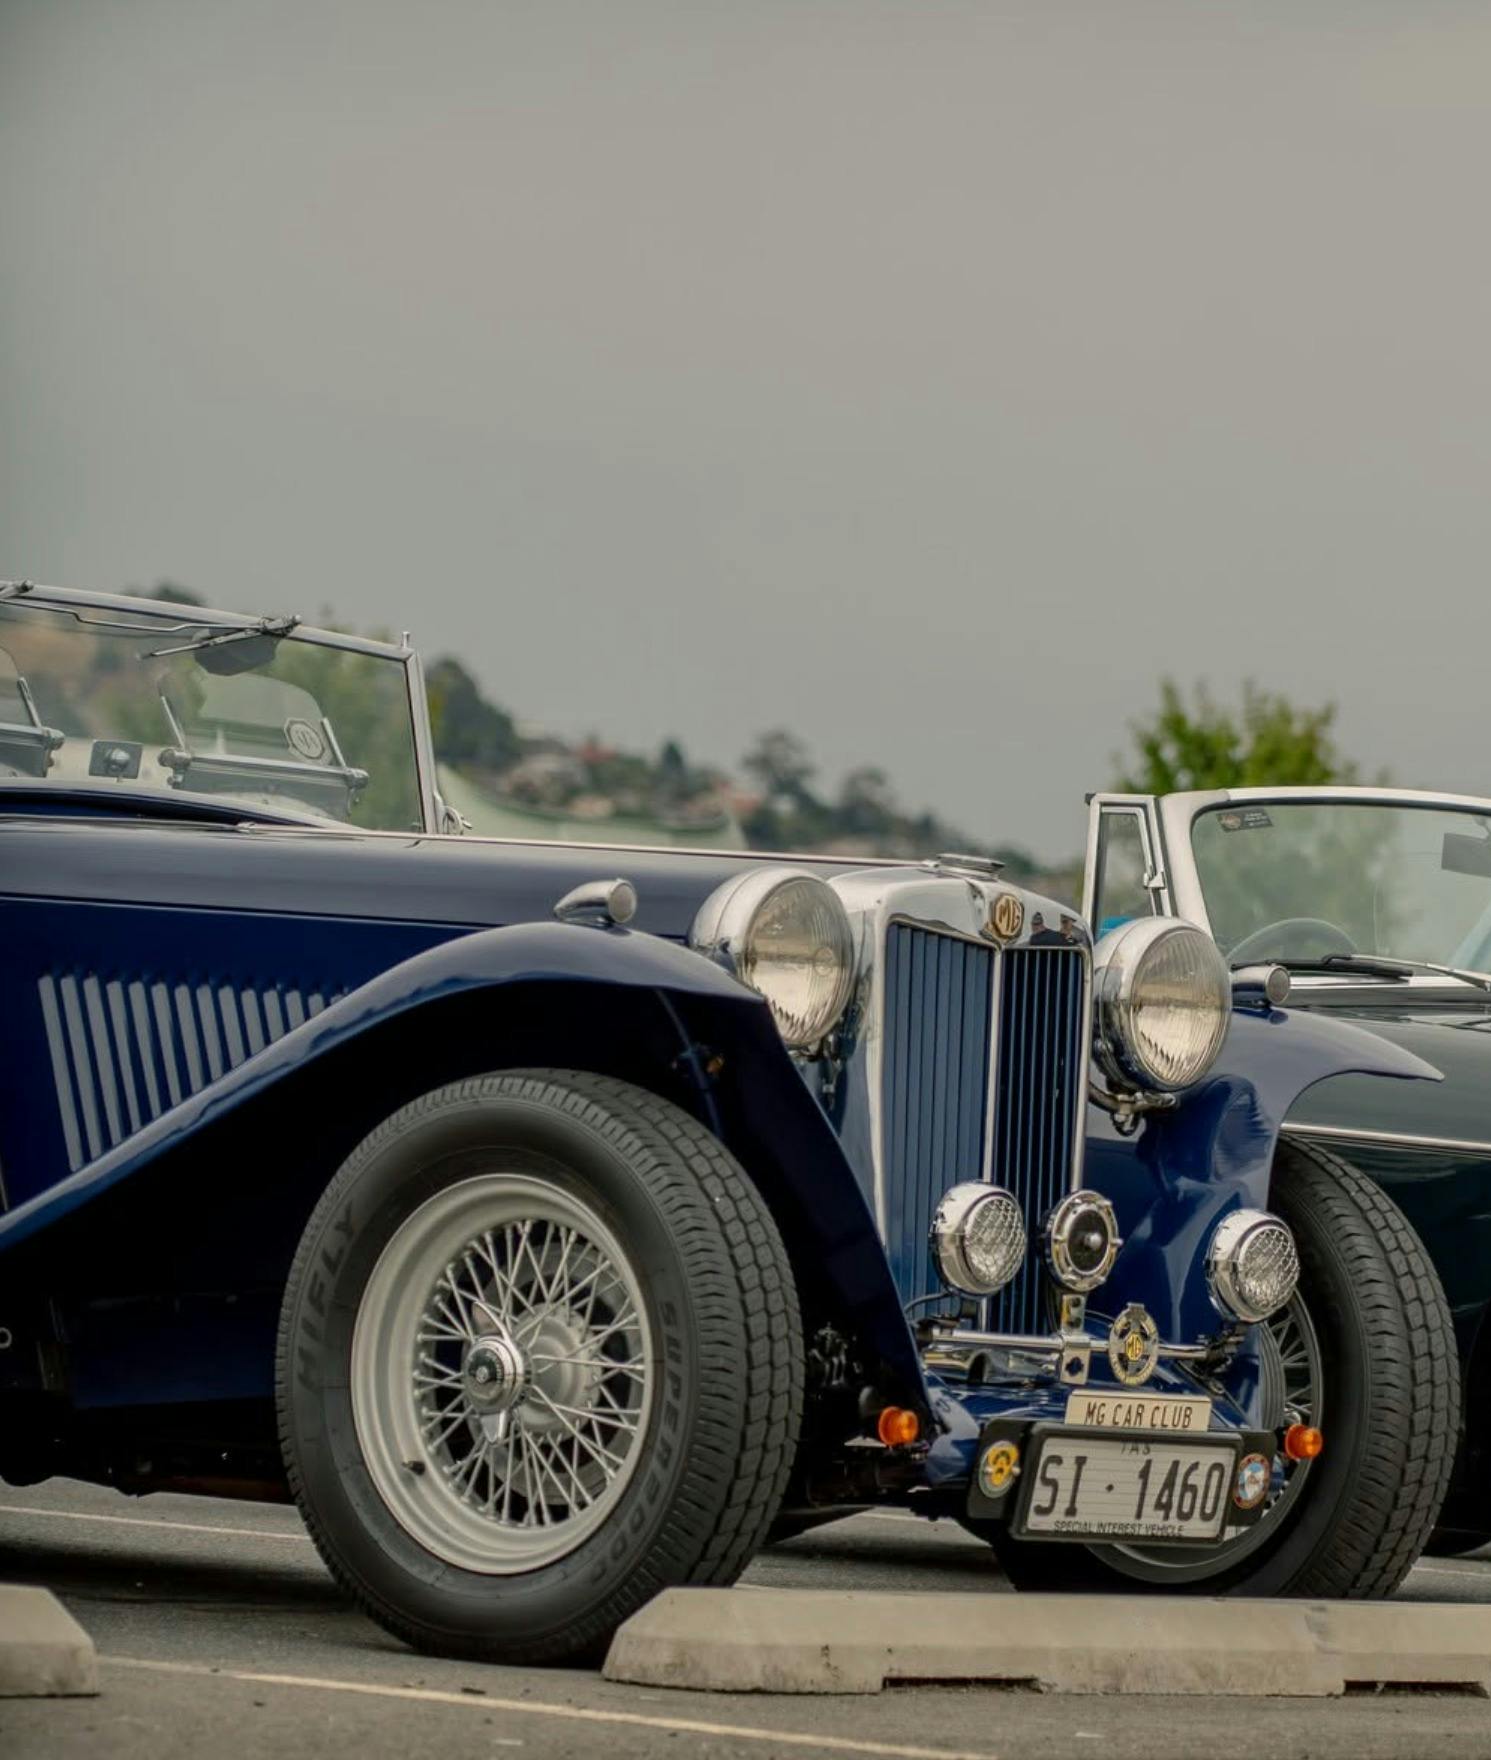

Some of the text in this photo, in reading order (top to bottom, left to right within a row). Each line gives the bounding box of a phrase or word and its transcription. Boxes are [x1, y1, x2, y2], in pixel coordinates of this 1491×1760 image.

[1084, 1401, 1193, 1428] MG CAR CLUB
[1033, 1454, 1088, 1518] SI
[1135, 1458, 1225, 1523] 1460
[1096, 1521, 1142, 1535] INTEREST
